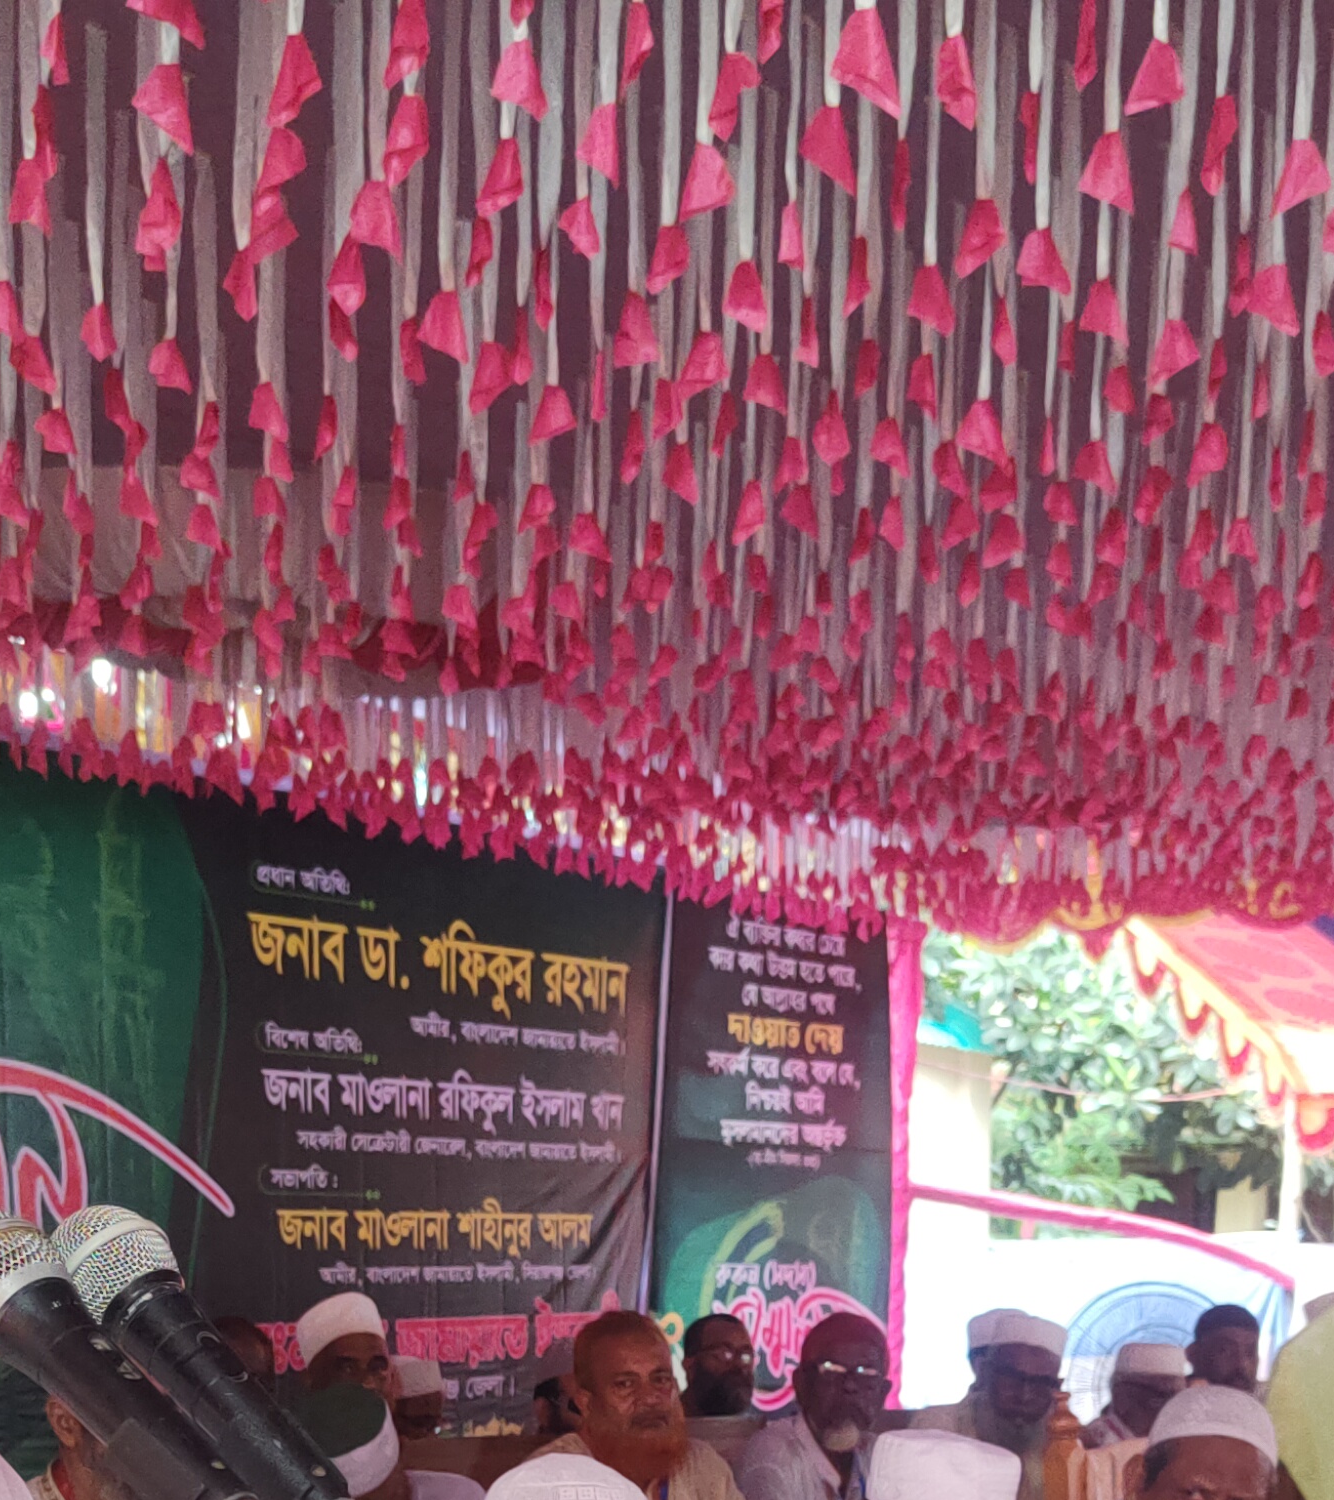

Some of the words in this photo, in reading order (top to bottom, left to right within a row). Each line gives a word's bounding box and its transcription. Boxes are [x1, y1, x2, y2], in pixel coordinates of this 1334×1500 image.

[246, 911, 349, 984] জনাব
[356, 924, 410, 990] ডা.
[419, 919, 536, 1021] শফিকুর
[541, 952, 631, 1019] রহমান
[265, 1020, 309, 1049] বিশেষ
[728, 1013, 801, 1048] দাওয়াত
[805, 1023, 844, 1055] দেয়
[261, 1066, 332, 1116] জনাব
[337, 1072, 433, 1120] মাওলানা
[436, 1067, 516, 1136] রফিকুল
[519, 1071, 587, 1129] ইসলাম
[590, 1091, 625, 1132] খান
[269, 1162, 329, 1189] সভাপতি
[276, 1206, 349, 1250] জনাব
[353, 1207, 451, 1250] মাওলানা
[456, 1196, 533, 1259] শাহীনুর
[537, 1210, 593, 1249] আলম
